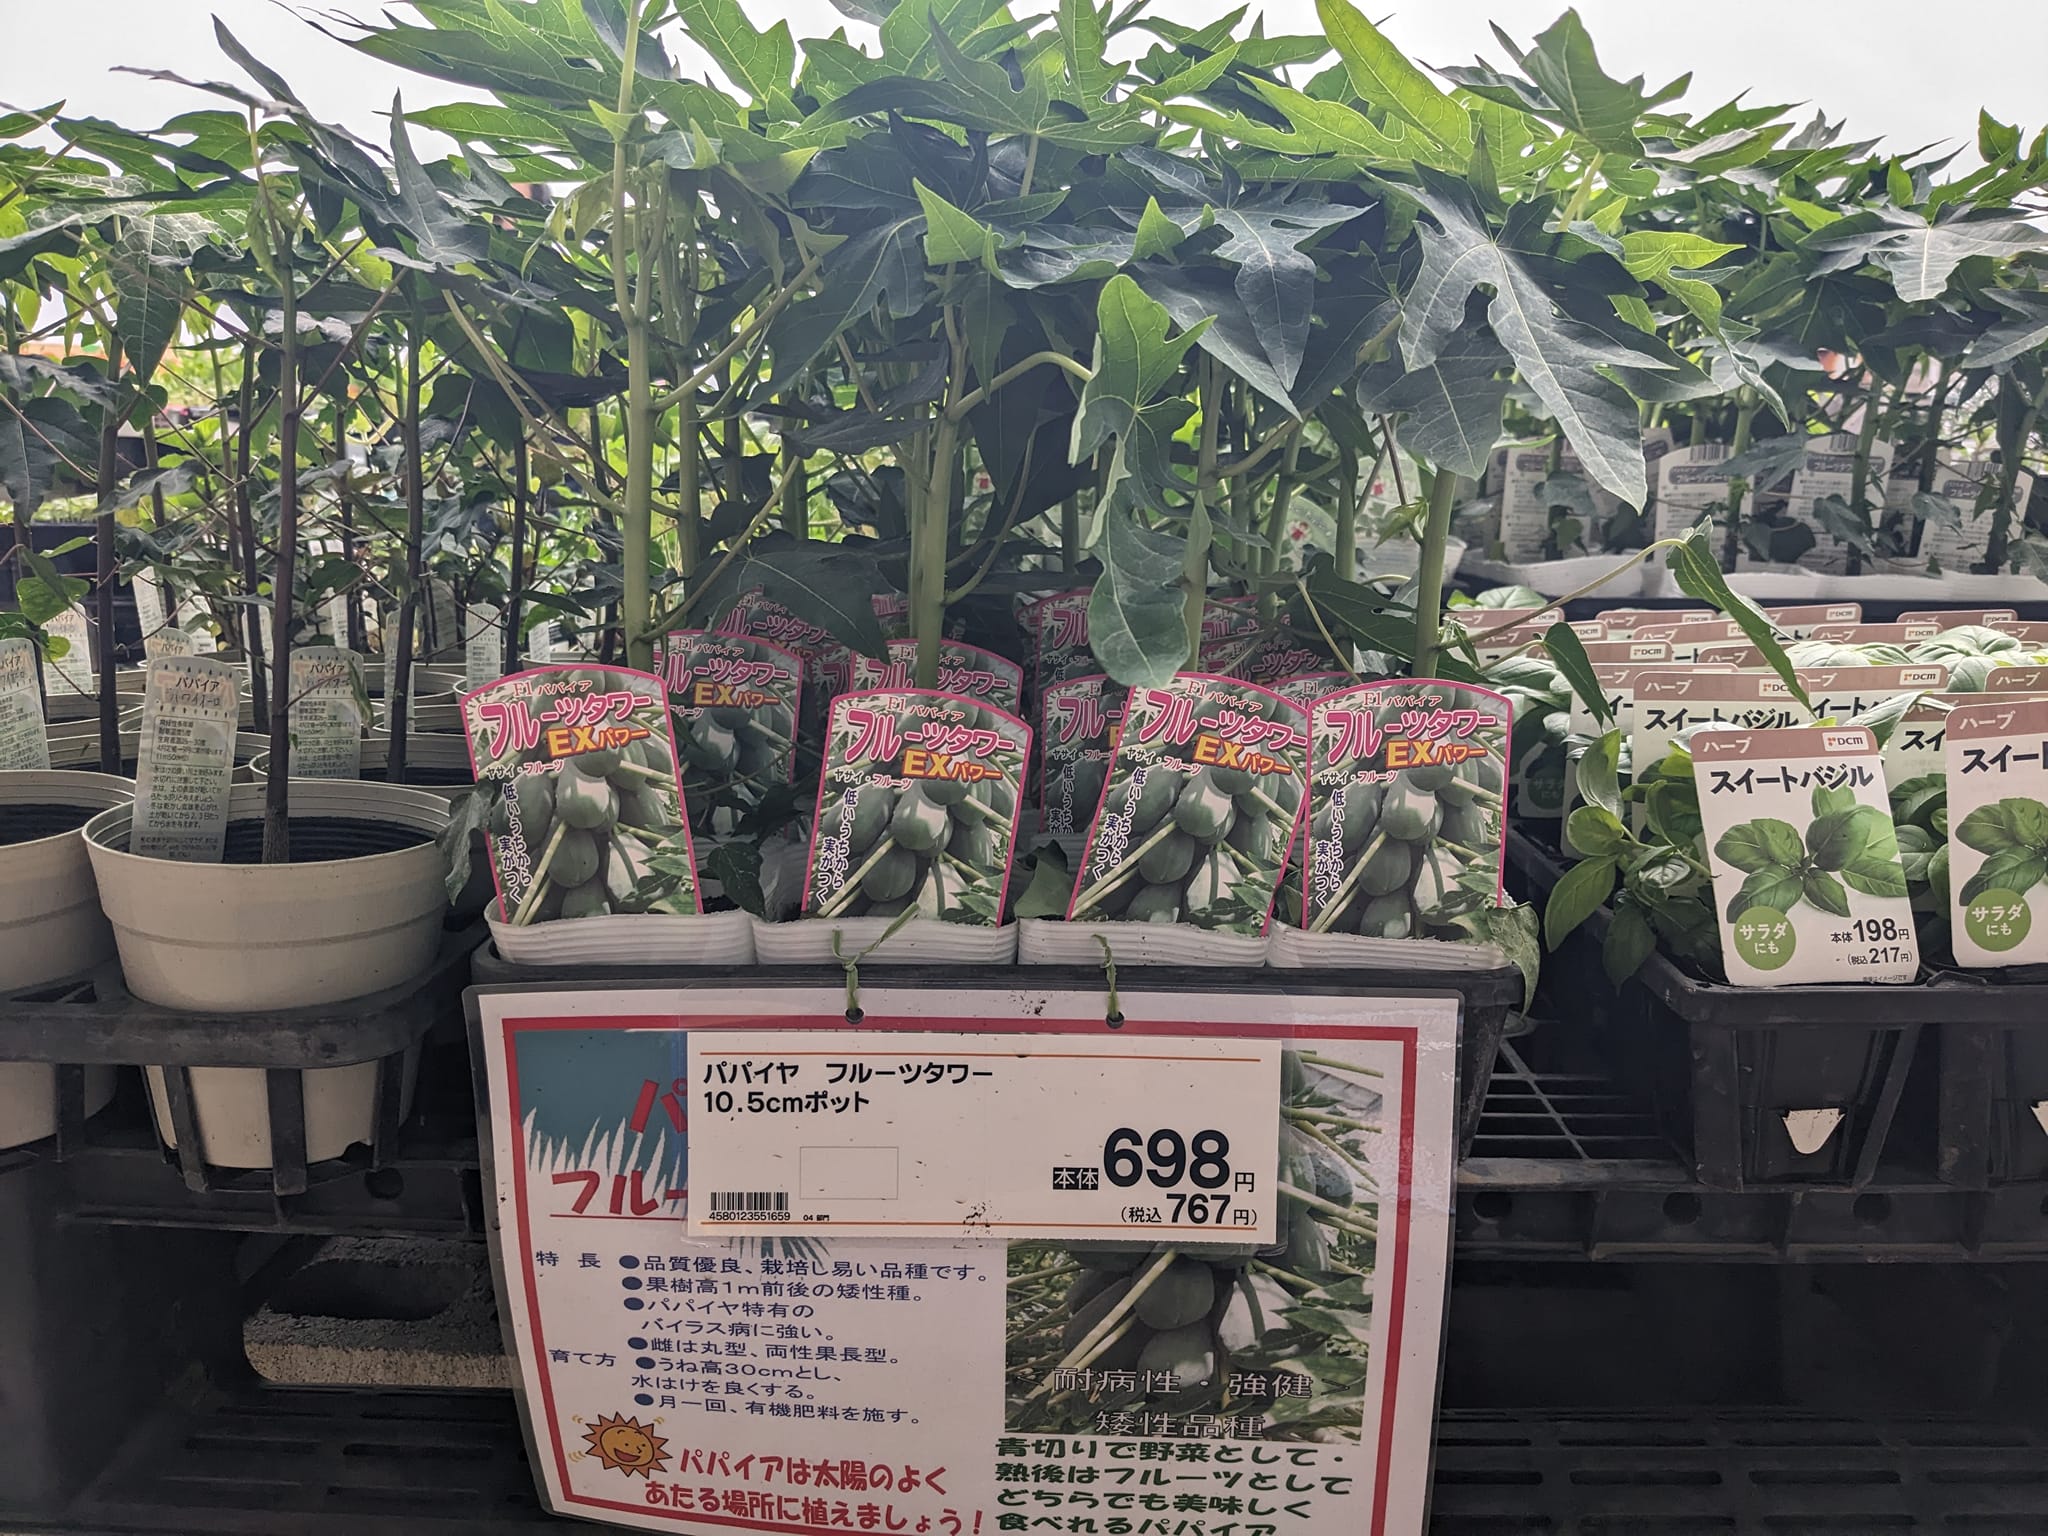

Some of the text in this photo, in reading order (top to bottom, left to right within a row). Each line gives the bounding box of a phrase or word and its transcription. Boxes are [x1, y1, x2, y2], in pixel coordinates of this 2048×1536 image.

[721, 607, 838, 645] ルーツタワー
[1642, 628, 1678, 641] ハーブ
[1819, 630, 1856, 642] ハーブ
[1914, 629, 1934, 637] DCM
[1641, 647, 1662, 656] DCM
[1707, 650, 1748, 664] ハーブ
[664, 652, 790, 695] ルーツタワー
[866, 657, 1009, 695] フルツタワー
[1806, 672, 1838, 687] ーブ
[1912, 672, 1937, 681] DCM
[1995, 671, 2042, 687] ハーブ
[513, 680, 592, 698] F1 パパイア
[693, 680, 782, 710] EXパワー
[1187, 680, 1207, 698] F1
[1207, 690, 1263, 713] パパイア
[1362, 692, 1443, 708] F1 パパイア
[1644, 678, 1693, 696] ハーブ
[887, 697, 966, 722] F1 パパイア
[1139, 689, 1308, 751] フルーツタワー
[1958, 710, 2016, 731] ハーブ
[479, 691, 653, 759] フルーツタワー
[845, 708, 1016, 763] フルーツタワー
[1325, 708, 1497, 765] フルーツタワー
[547, 725, 650, 757] EXパワー
[1703, 736, 1753, 754] ハーブ
[1837, 736, 1864, 747] DCM
[902, 748, 1003, 785] EXパワー
[1052, 748, 1114, 761] ヤサイ・フルー
[1126, 746, 1202, 776] ヤサイ・フルーツ
[1193, 733, 1293, 776] EXパワー
[1385, 739, 1488, 770] EXパワー
[486, 759, 565, 781] ヤサイ・フルーツ
[833, 767, 913, 791] ヤサイ・フルーツ
[1319, 769, 1399, 786] ヤサイ・フルーツ
[1709, 763, 1875, 795] スイートバジル
[1061, 763, 1075, 833] 低いうちか
[1110, 766, 1148, 868] 低いうちから
[502, 782, 533, 888] 低いうちから
[832, 786, 859, 890] 低いうちから
[1092, 813, 1120, 882] 実がつく
[1328, 787, 1347, 893] 低いうちから
[498, 836, 522, 905] 実がつく
[816, 835, 837, 906] 実がつく
[1314, 839, 1331, 909] 実がつく
[1971, 903, 2026, 922] サラダ
[1738, 921, 1789, 941] サラダ
[1986, 922, 2013, 937] にも
[1753, 941, 1780, 955] にも
[703, 1061, 993, 1085] パパイヤ フルーツタワー
[630, 1079, 688, 1134] パ
[703, 1090, 870, 1114] 10.5cmポット
[551, 1169, 688, 1216] フルー
[709, 1211, 791, 1221] 4580123551659
[803, 1214, 814, 1222] 04
[643, 1256, 988, 1282] 品質優良、栽培し易い品種です。
[645, 1276, 923, 1302] 果樹高1m前後の矮性種。
[647, 1297, 815, 1319] パパイヤ特有の
[641, 1319, 836, 1342] バイラス病に強い。
[550, 1348, 618, 1369] 育て方
[651, 1337, 900, 1365] 雌は丸型、両性果長型。
[657, 1357, 843, 1382] うね高30cmとし、
[631, 1374, 816, 1401] 水はけを良くする。
[658, 1393, 921, 1425] 月一回、有機肥料を施す。
[1095, 1410, 1268, 1440] 矮性品種
[679, 1448, 950, 1497] パパイアは太陽のよく
[994, 1461, 1354, 1496] 熟後はフルーツとして
[996, 1488, 1314, 1519] どちらでも美味しく
[995, 1511, 1278, 1536] 食べれるパパイア
